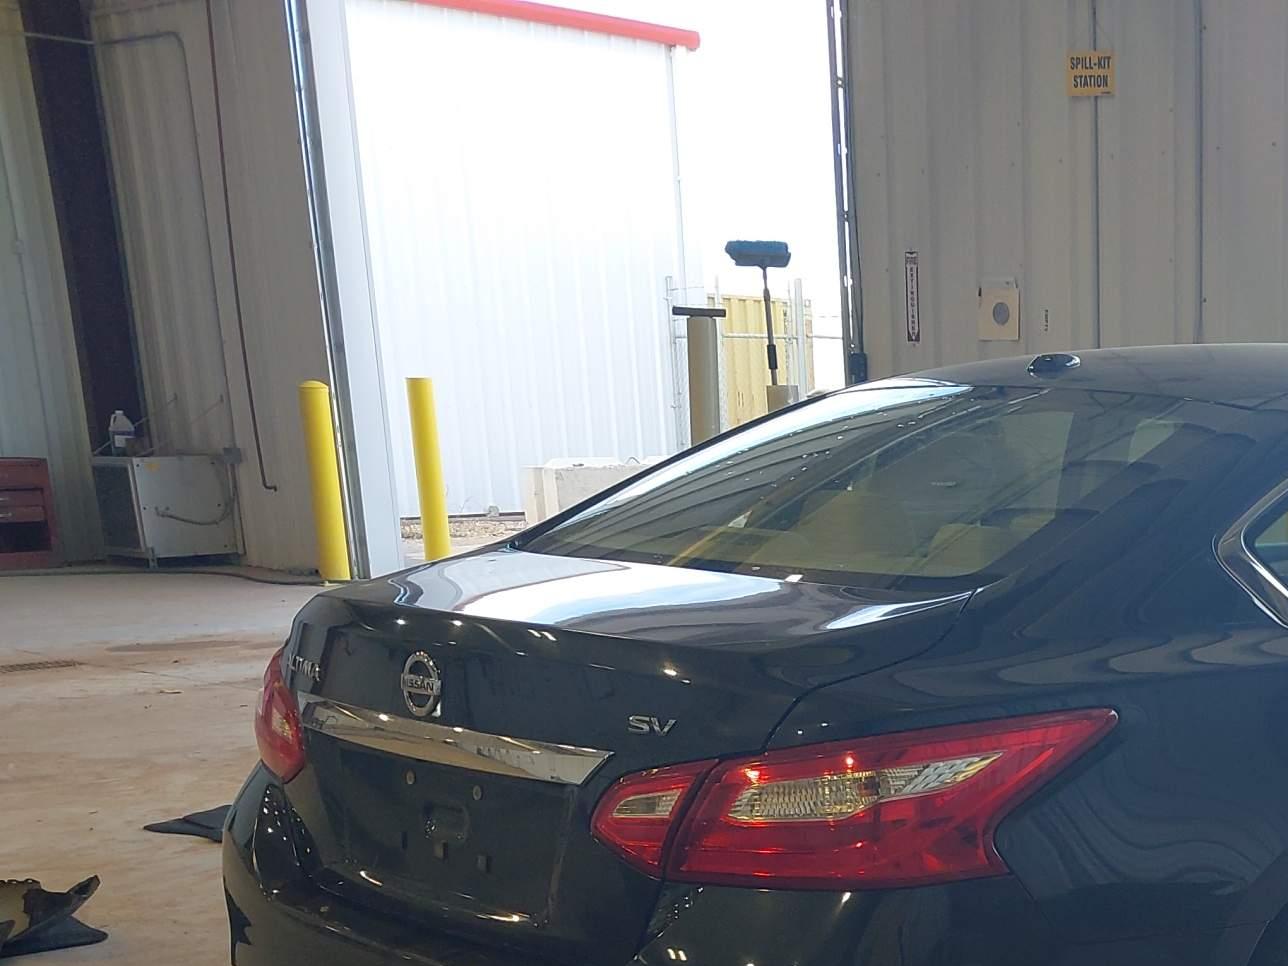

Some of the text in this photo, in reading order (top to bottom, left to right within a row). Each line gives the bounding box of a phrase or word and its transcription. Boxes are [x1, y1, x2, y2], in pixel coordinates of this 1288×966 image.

[1070, 56, 1112, 70] SPILL-KIT
[1073, 75, 1109, 88] STATION
[627, 715, 677, 736] SV
